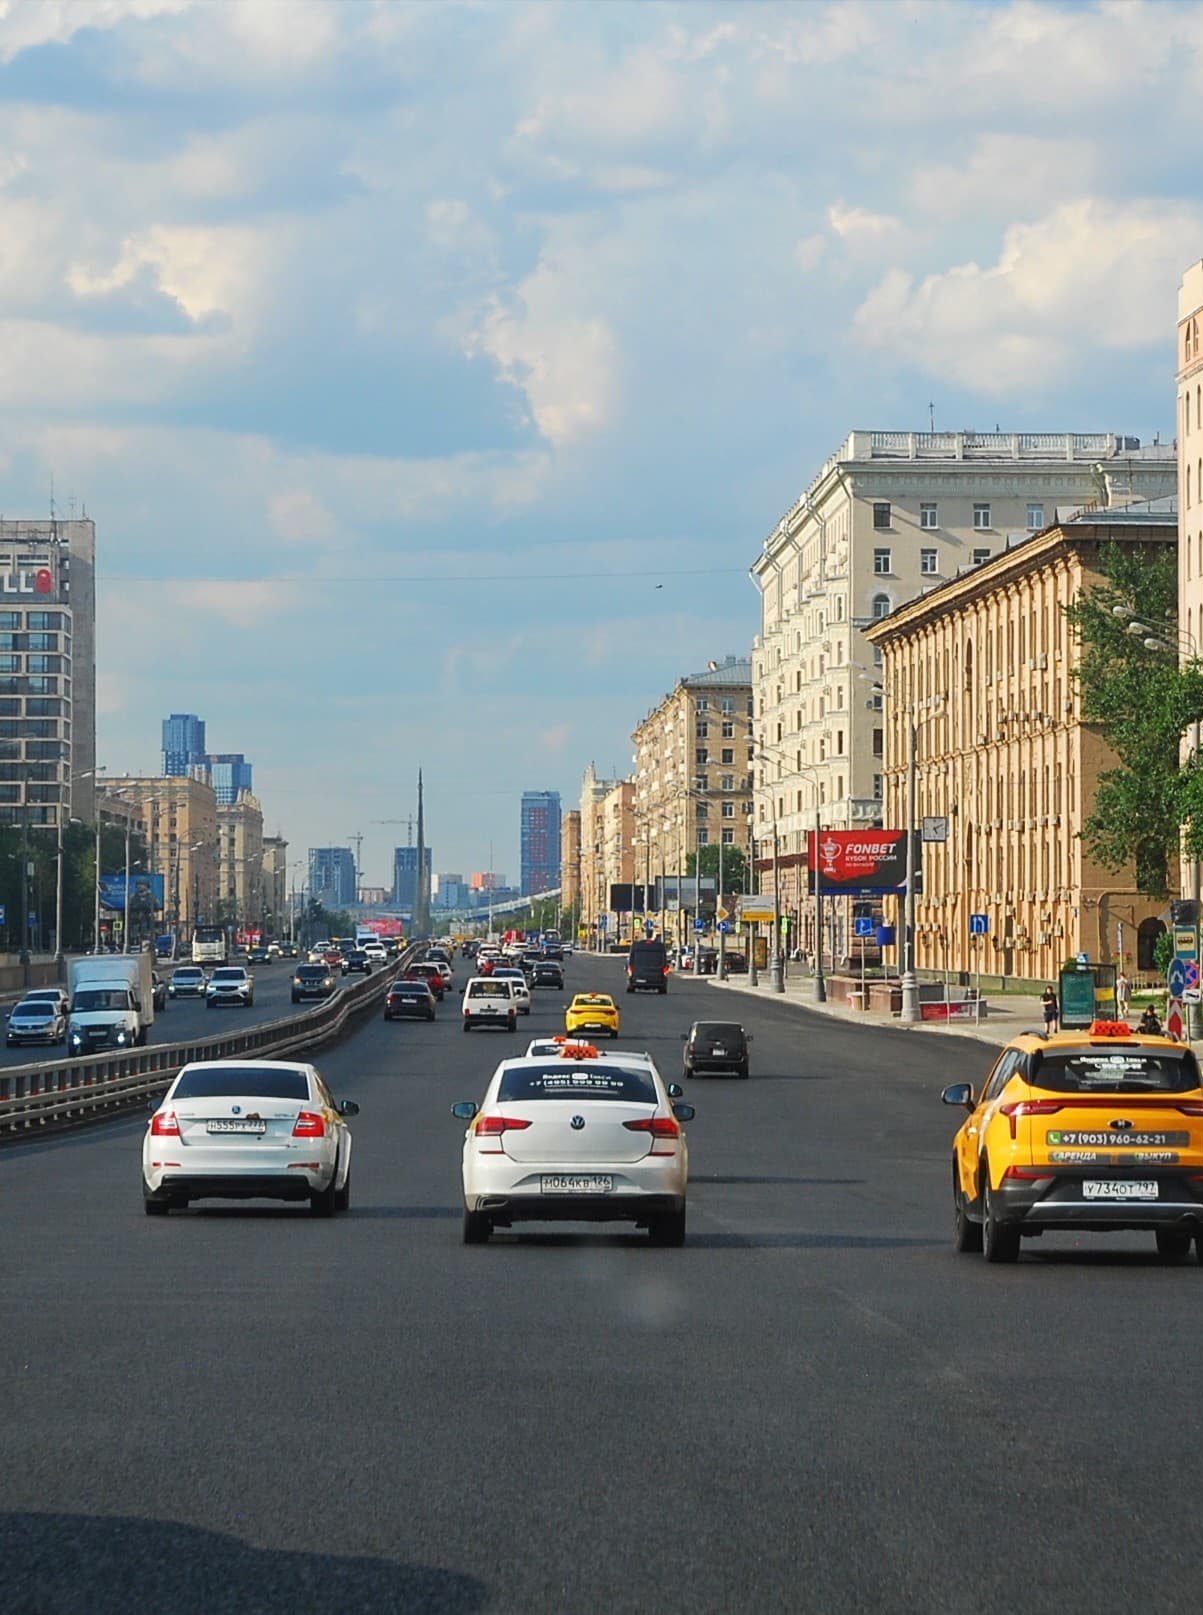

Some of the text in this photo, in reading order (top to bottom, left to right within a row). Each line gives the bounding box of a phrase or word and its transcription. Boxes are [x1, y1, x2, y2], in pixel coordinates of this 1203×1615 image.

[845, 843, 897, 854] FONBET
[1062, 1133, 1166, 1145] +7 (903) 960-62-21
[1059, 1152, 1097, 1161] АРЕНДА
[1138, 1152, 1172, 1161] ВЫКУП
